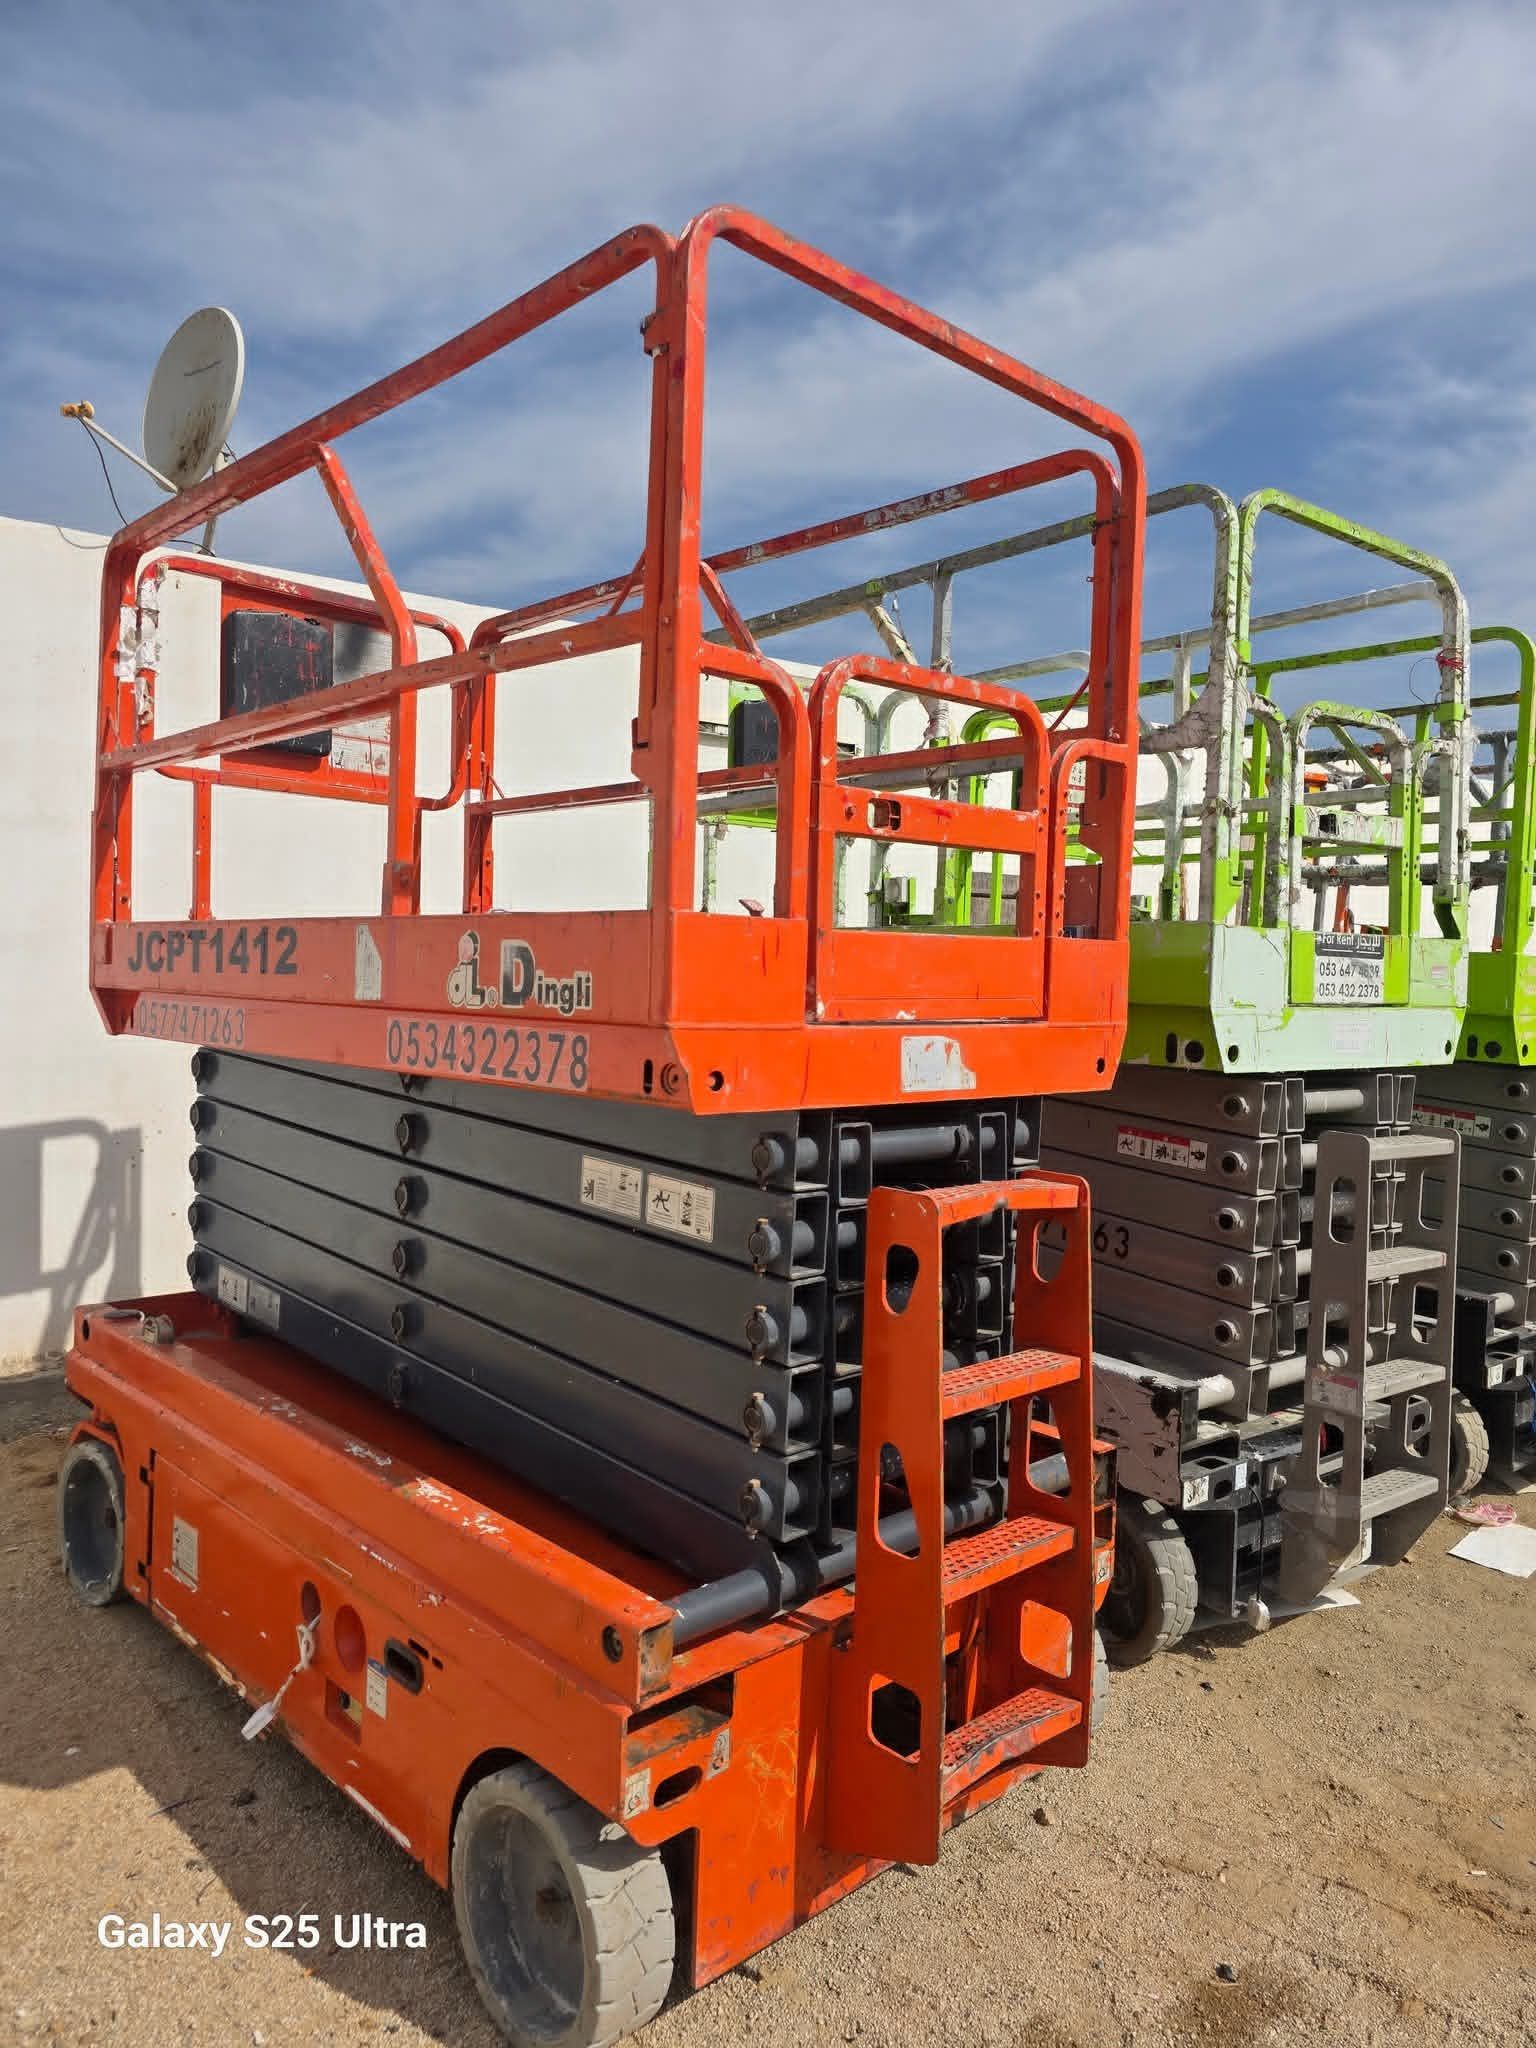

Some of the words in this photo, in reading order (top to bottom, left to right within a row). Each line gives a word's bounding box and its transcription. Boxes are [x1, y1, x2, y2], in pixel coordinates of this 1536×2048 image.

[128, 926, 298, 975] JCPT1412
[1319, 961, 1337, 977] 053
[1339, 963, 1356, 977] 647
[501, 939, 593, 1016] Dingli
[1318, 982, 1336, 997] 053
[1338, 983, 1356, 998] 432
[1357, 984, 1380, 999] 2378
[140, 999, 245, 1045] 0577471263
[388, 1019, 589, 1089] 0534322378
